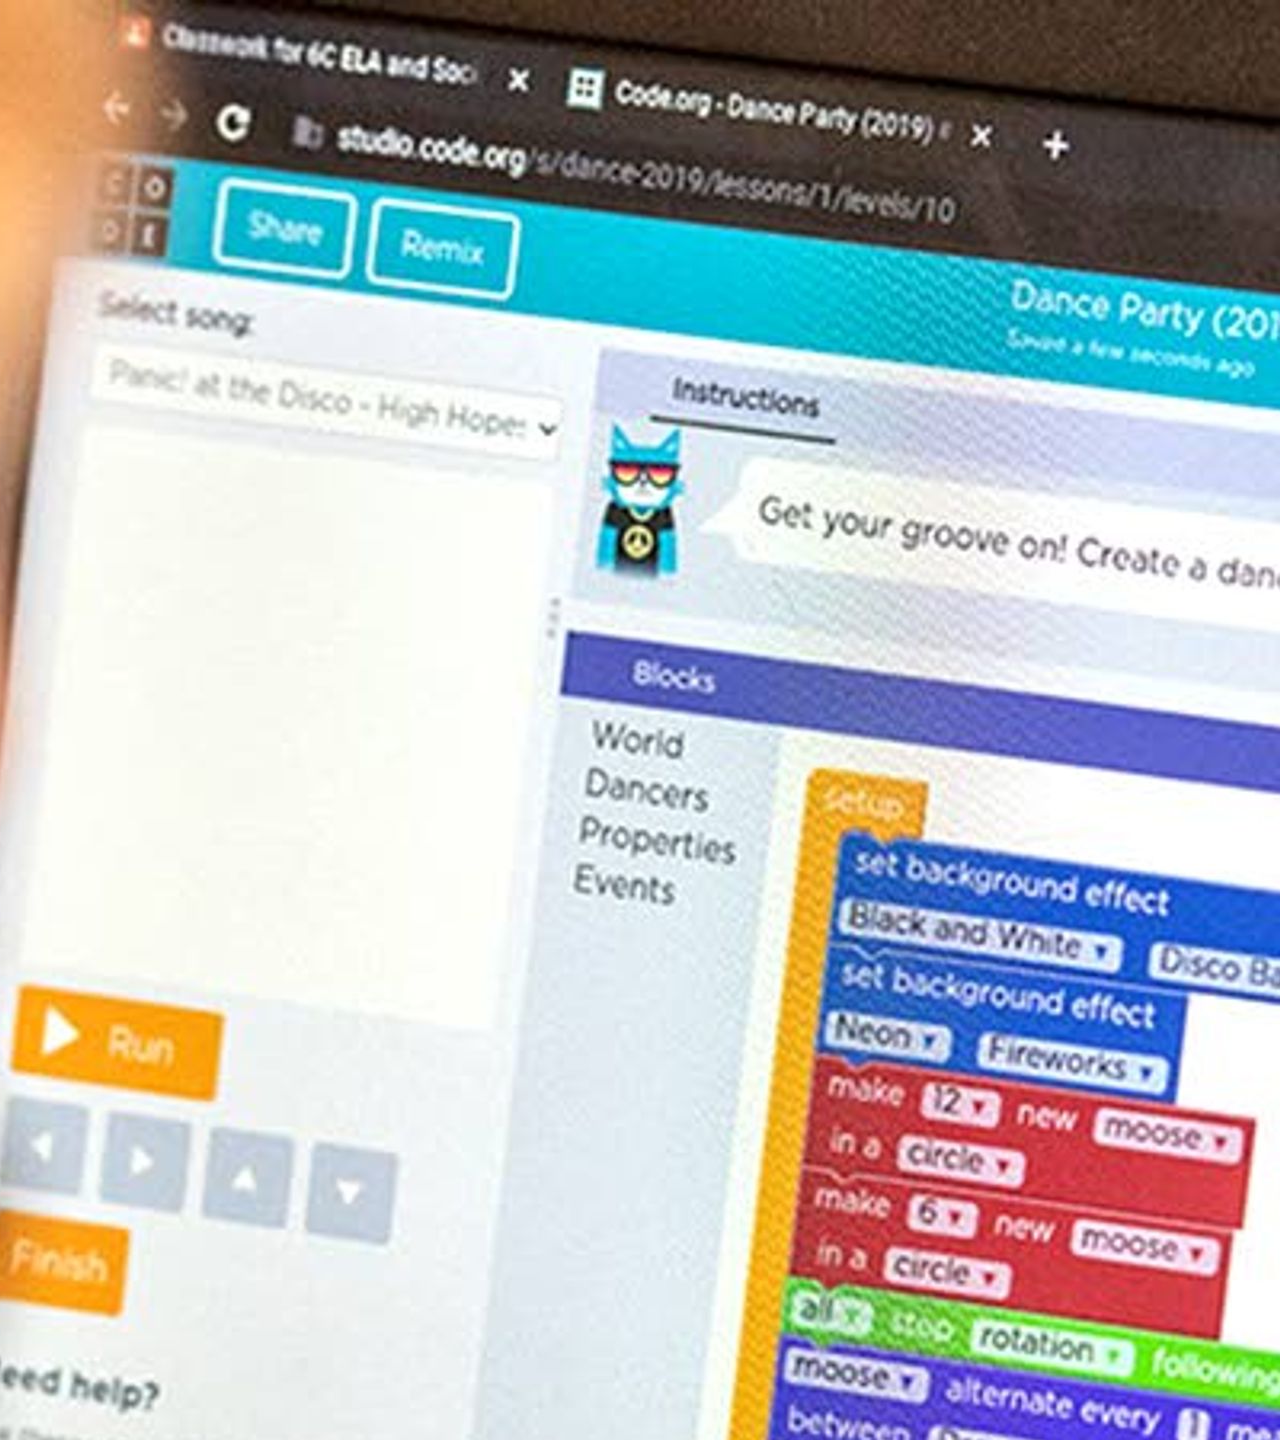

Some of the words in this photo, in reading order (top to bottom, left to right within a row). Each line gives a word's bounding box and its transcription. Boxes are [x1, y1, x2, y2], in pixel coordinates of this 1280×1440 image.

[163, 23, 266, 61] Classwork
[274, 38, 304, 64] for
[308, 40, 336, 68] 6C
[340, 45, 382, 75] ELA
[388, 53, 429, 81] and
[615, 78, 711, 119] Code.org
[727, 92, 795, 127] Dance
[799, 99, 858, 136] Party
[861, 107, 934, 143] (2019)
[247, 209, 324, 246] Share
[402, 230, 485, 266] Remix
[99, 290, 179, 327] Select
[185, 300, 255, 338] song:
[1012, 279, 1110, 321] Dance
[1120, 293, 1203, 338] Party
[1007, 329, 1066, 356] Saved
[1072, 342, 1083, 354] a
[1087, 341, 1123, 364] few
[1129, 346, 1210, 374] seconds
[1215, 359, 1255, 380] ago
[109, 358, 190, 396] Panic!
[195, 370, 224, 400] at
[230, 374, 271, 406] the
[283, 381, 352, 418] Disco
[379, 395, 440, 437] High
[673, 377, 820, 418] Instructions
[759, 494, 813, 530] Get
[823, 505, 893, 541] your
[901, 518, 1008, 557] groove
[1020, 532, 1067, 562] on!
[1078, 537, 1180, 579] Create
[1187, 557, 1207, 581] a
[633, 661, 716, 696] Blocks
[593, 721, 685, 760] World
[585, 769, 710, 813] Dancers
[822, 785, 904, 823] setup
[579, 816, 738, 866] Properties
[573, 864, 676, 906] Events
[855, 849, 898, 879] set
[907, 853, 1080, 908] background
[1086, 880, 1172, 917] effect
[848, 900, 926, 938] Black
[936, 915, 988, 948] and
[998, 921, 1082, 963] White
[1160, 946, 1241, 984] Disco
[842, 959, 884, 991] set
[893, 960, 1065, 1019] background
[1072, 991, 1159, 1032] effect
[108, 1024, 174, 1068] Run
[836, 1015, 912, 1051] Neon
[988, 1035, 1128, 1083] Fireworks
[828, 1073, 906, 1108] make
[931, 1086, 963, 1116] 12
[1017, 1101, 1080, 1132] new
[1103, 1114, 1204, 1151] moose
[830, 1126, 856, 1156] in
[862, 1138, 881, 1160] a
[906, 1143, 987, 1177] circle
[815, 1184, 893, 1221] make
[917, 1200, 938, 1226] 6
[994, 1213, 1056, 1244] new
[1080, 1226, 1180, 1261] moose
[9, 1239, 109, 1285] Finish
[817, 1242, 844, 1268] in
[847, 1250, 867, 1271] a
[893, 1251, 973, 1287] circle
[799, 1296, 833, 1323] all
[891, 1308, 956, 1345] stop
[980, 1324, 1097, 1365] rotation
[70, 1371, 161, 1415] help?
[792, 1357, 891, 1393] moose
[945, 1377, 1074, 1420] alternate
[1080, 1402, 1161, 1437] every
[1187, 1413, 1200, 1439] 1
